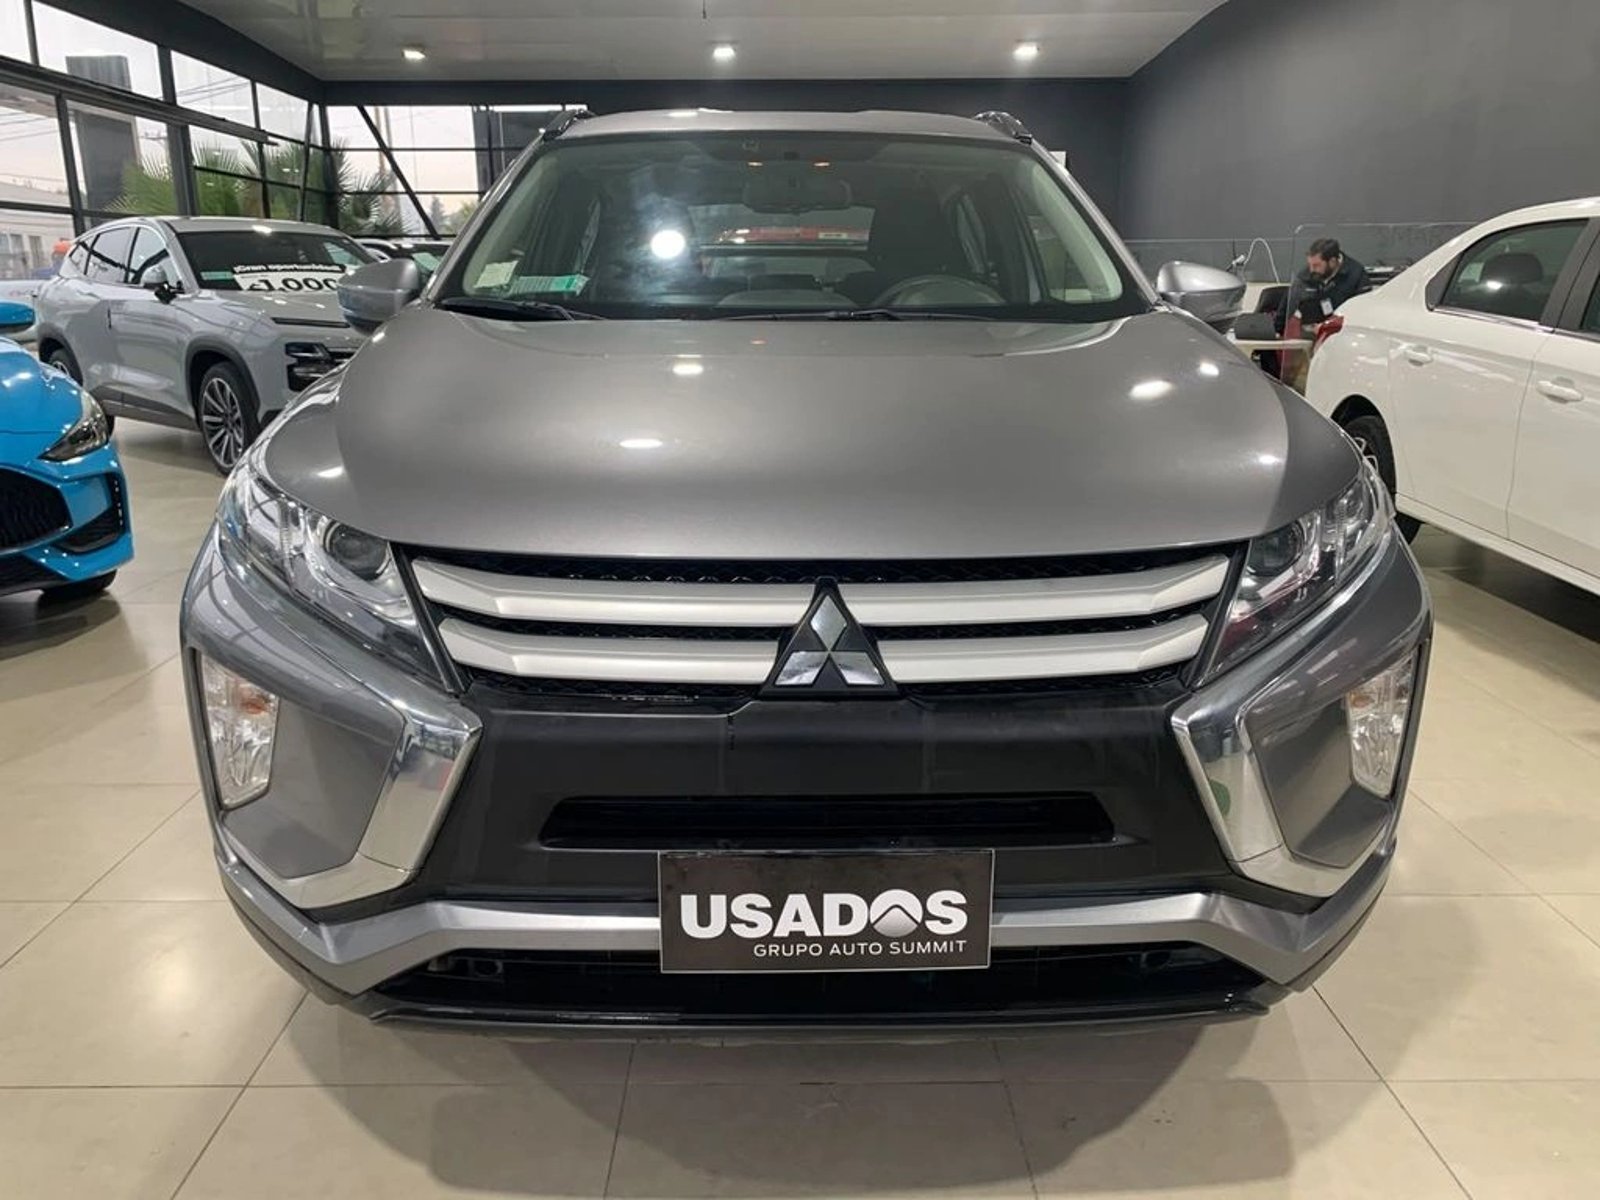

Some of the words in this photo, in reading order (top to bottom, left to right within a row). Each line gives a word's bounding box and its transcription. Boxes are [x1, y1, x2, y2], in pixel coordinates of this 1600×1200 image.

[680, 889, 968, 939] USADOS
[753, 943, 823, 958] GRUPO
[829, 942, 883, 956] AUTO
[889, 940, 968, 955] SUMMIT
